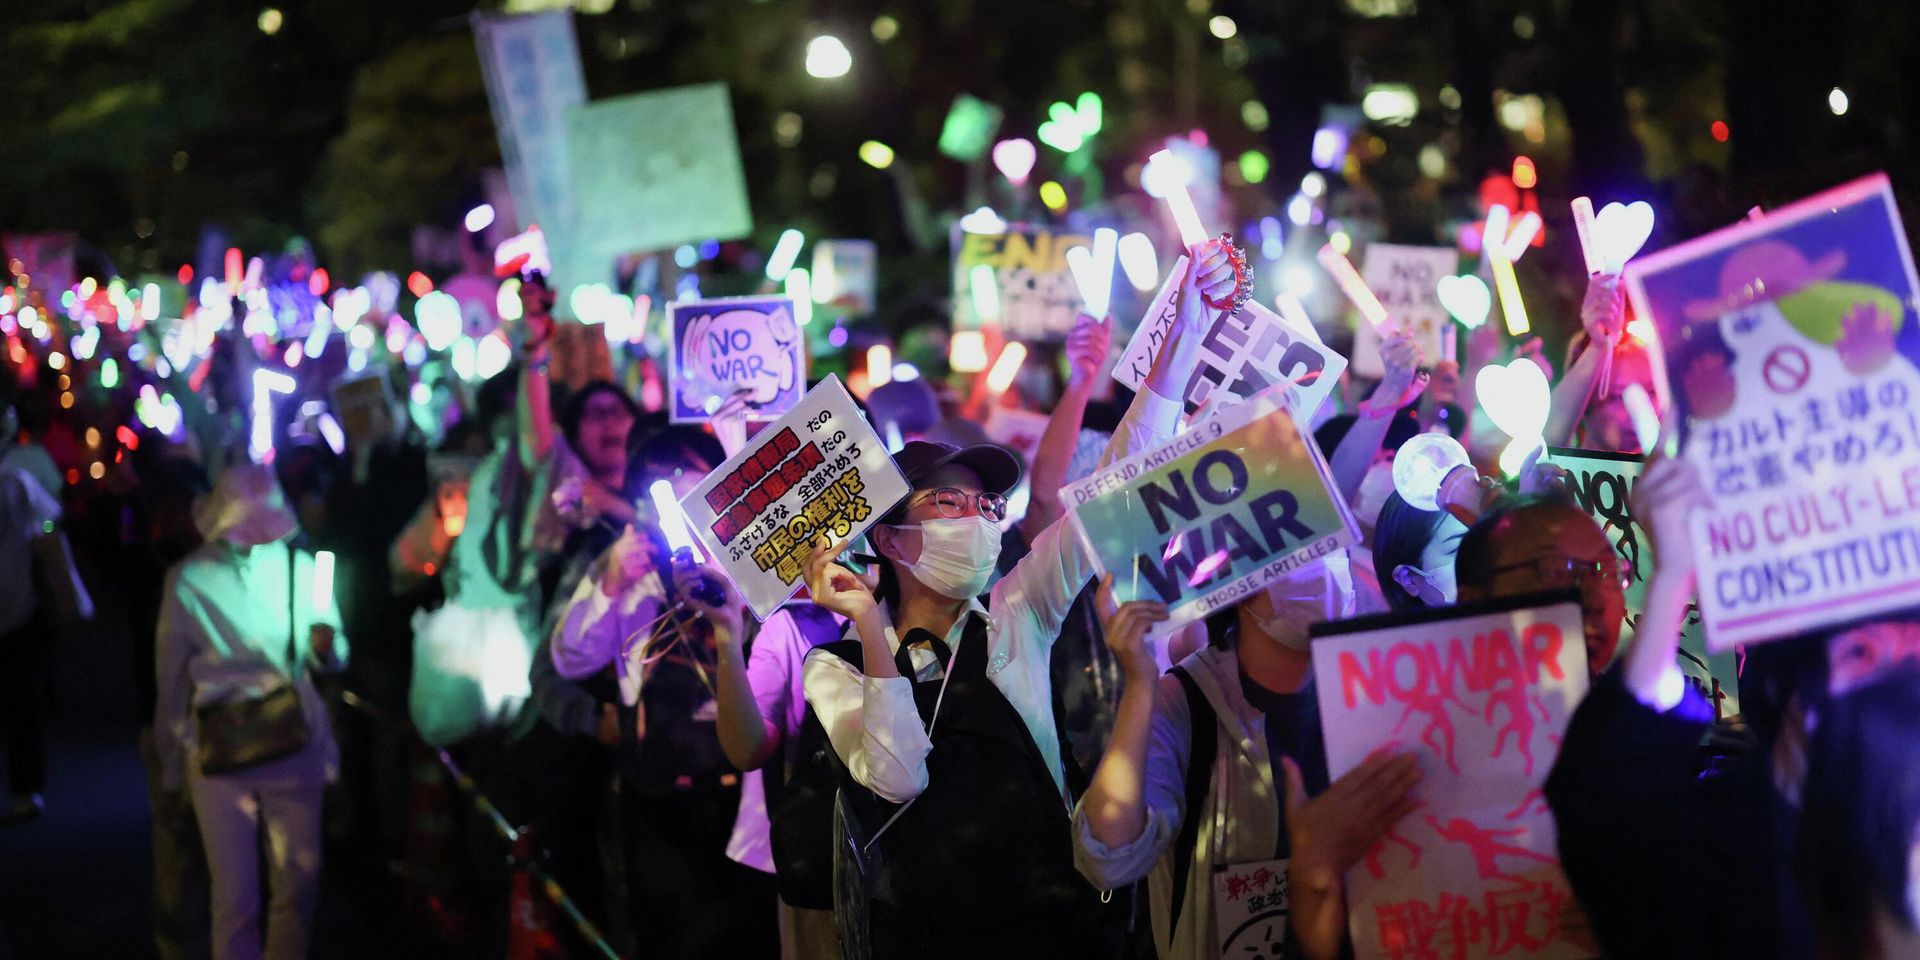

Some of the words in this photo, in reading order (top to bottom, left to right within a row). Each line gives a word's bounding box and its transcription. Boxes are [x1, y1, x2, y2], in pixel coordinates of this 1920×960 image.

[708, 329, 752, 357] NO
[710, 354, 778, 382] WAR
[806, 409, 832, 433] だの
[821, 429, 846, 455] だの
[1073, 462, 1138, 504] DEFEND
[1142, 434, 1202, 472] ARTICLE
[1208, 421, 1222, 437] 9
[1137, 449, 1248, 535] NO
[729, 504, 789, 561] ふざけるな
[797, 442, 862, 502] 全部やめろ
[751, 466, 865, 572] 市民の権利を
[1133, 489, 1315, 604] WAR
[1707, 511, 1756, 558] NO
[1195, 577, 1260, 614] CHOOSE
[1263, 544, 1325, 583] ARTICLE
[1327, 536, 1338, 553] 9
[1247, 888, 1288, 914] 政治
